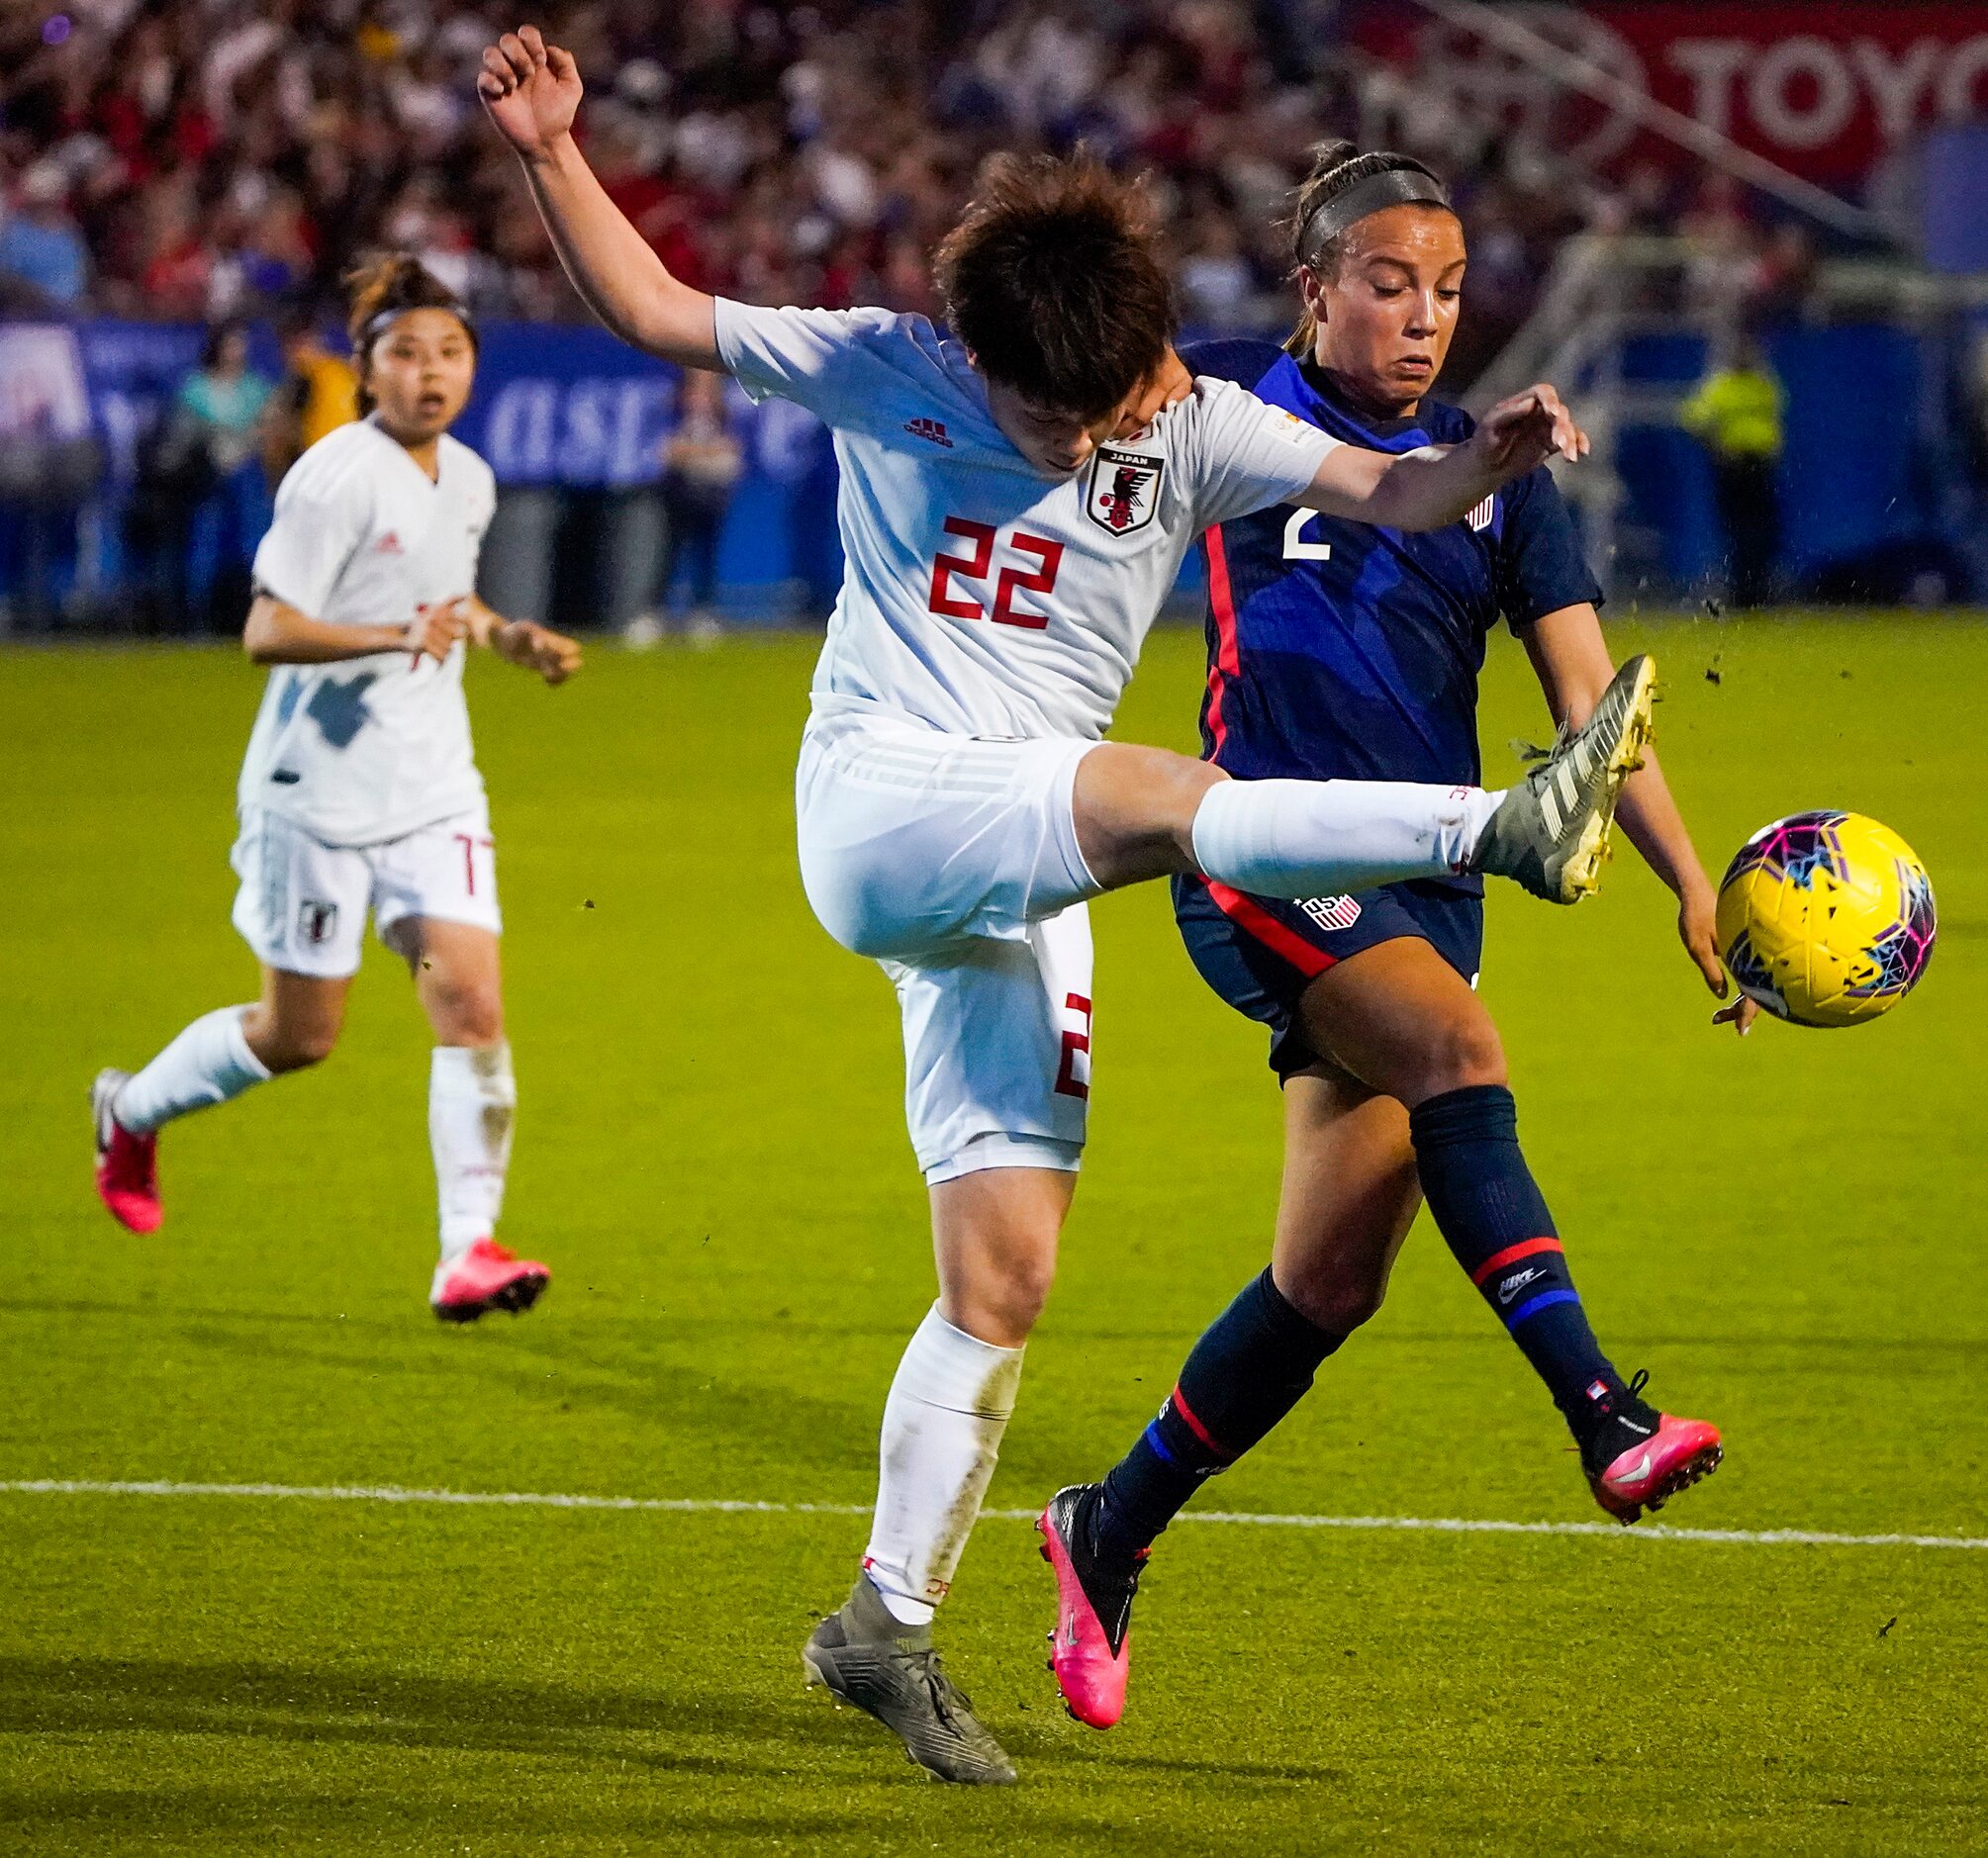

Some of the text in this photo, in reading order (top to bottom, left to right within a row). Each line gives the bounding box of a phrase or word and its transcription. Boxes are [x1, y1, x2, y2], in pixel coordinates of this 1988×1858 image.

[903, 424, 954, 448] adidas
[1110, 452, 1149, 466] JAPAN
[1282, 507, 1331, 560] 2
[929, 514, 1065, 630] 22
